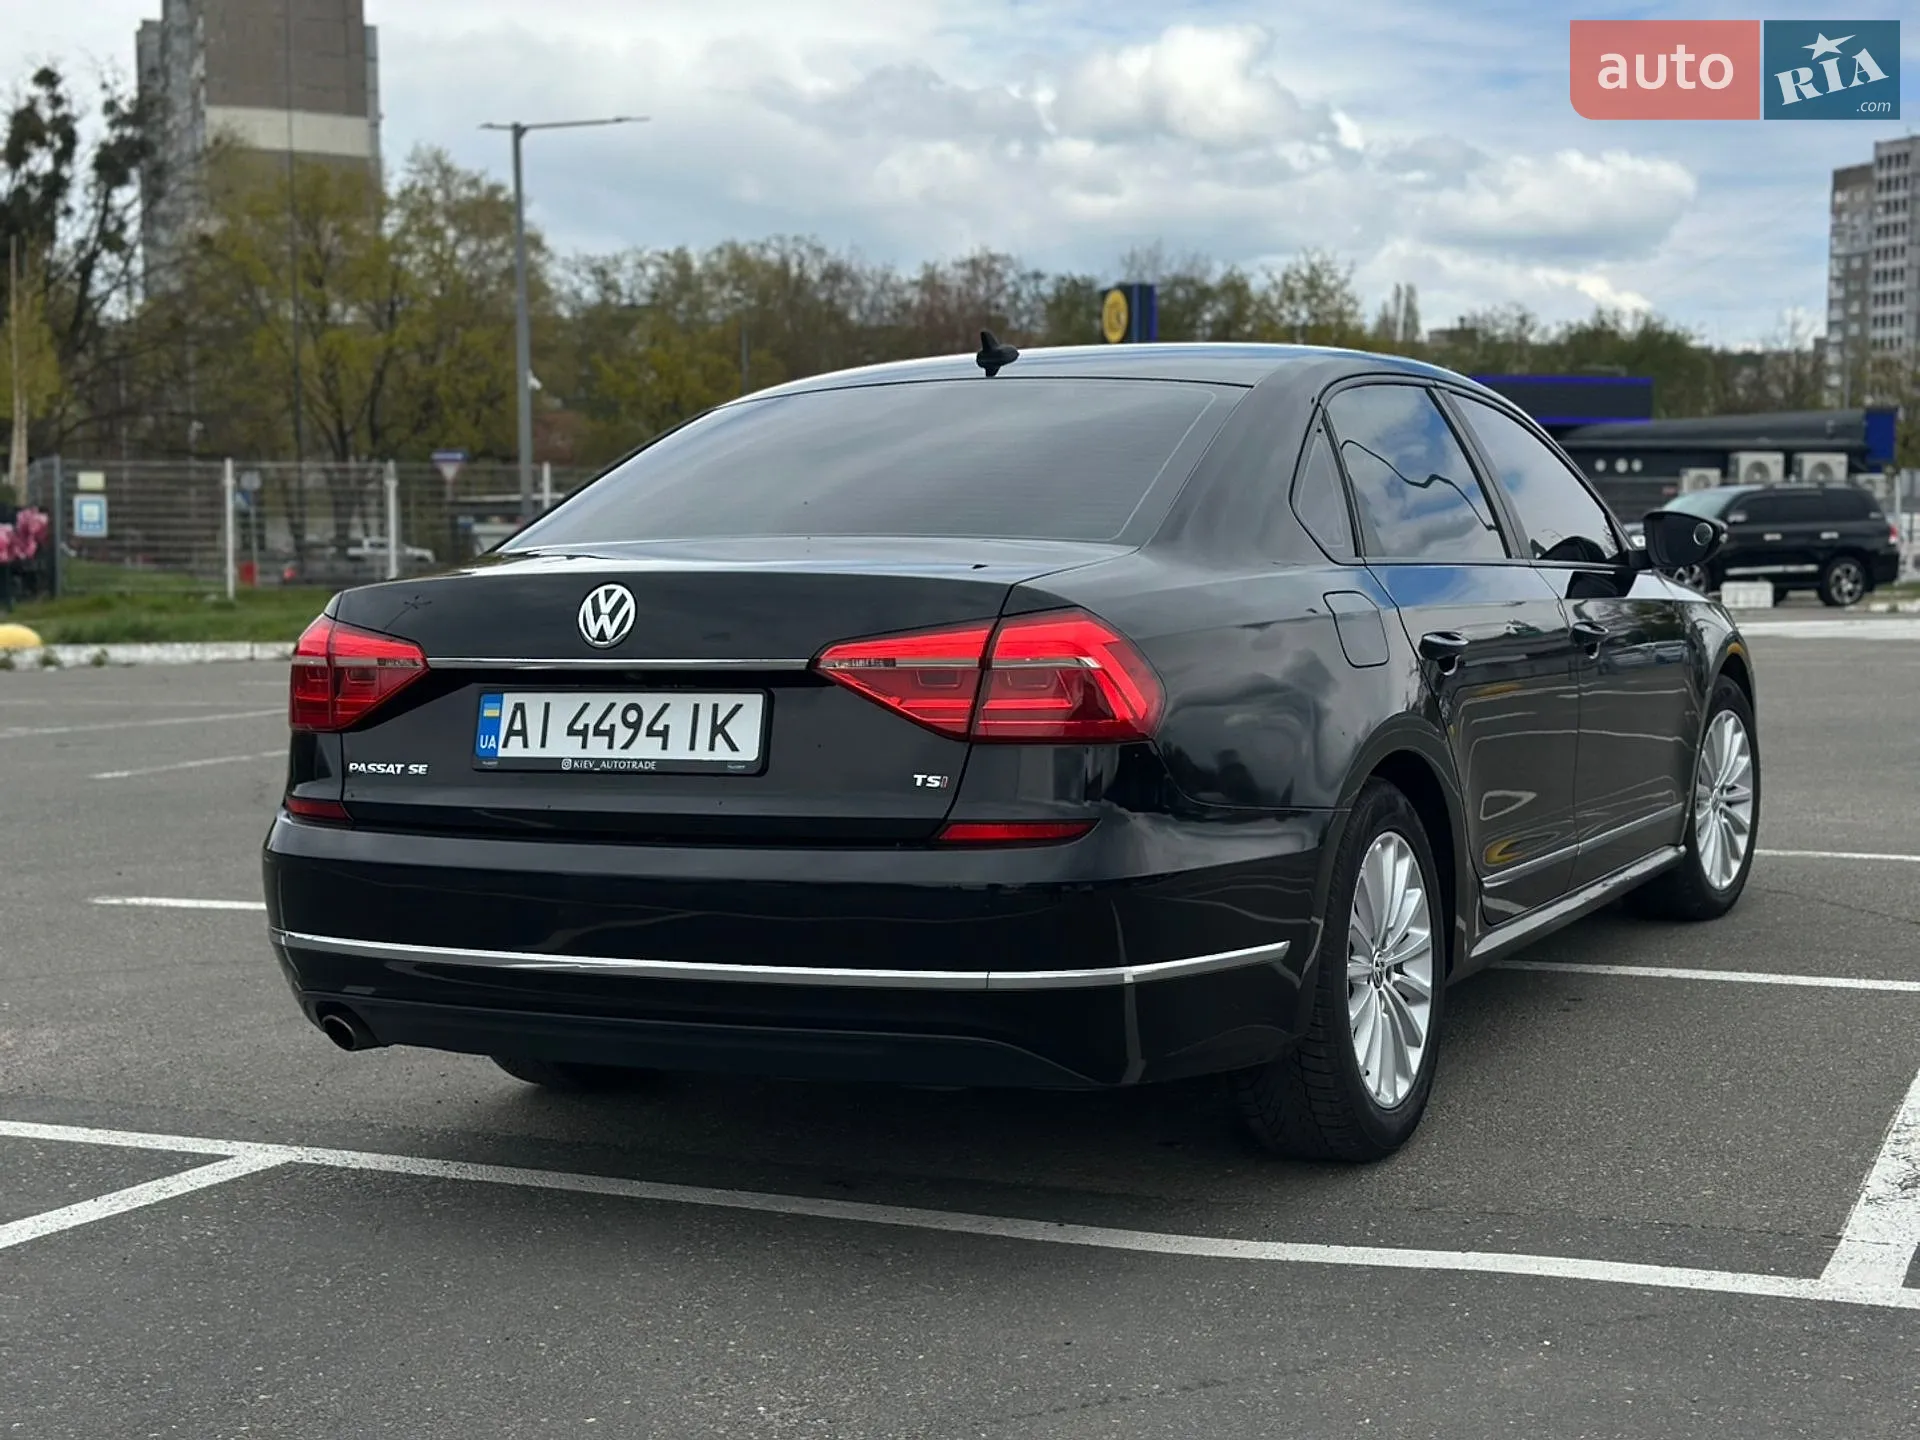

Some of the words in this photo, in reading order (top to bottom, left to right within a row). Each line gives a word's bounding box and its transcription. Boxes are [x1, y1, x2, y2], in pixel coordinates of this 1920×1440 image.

[501, 702, 550, 749] AI
[566, 702, 671, 750] 4494
[688, 703, 744, 752] IK
[480, 734, 497, 749] UA
[348, 762, 405, 775] PASSAT
[407, 763, 429, 775] SE
[912, 774, 949, 788] TSI
